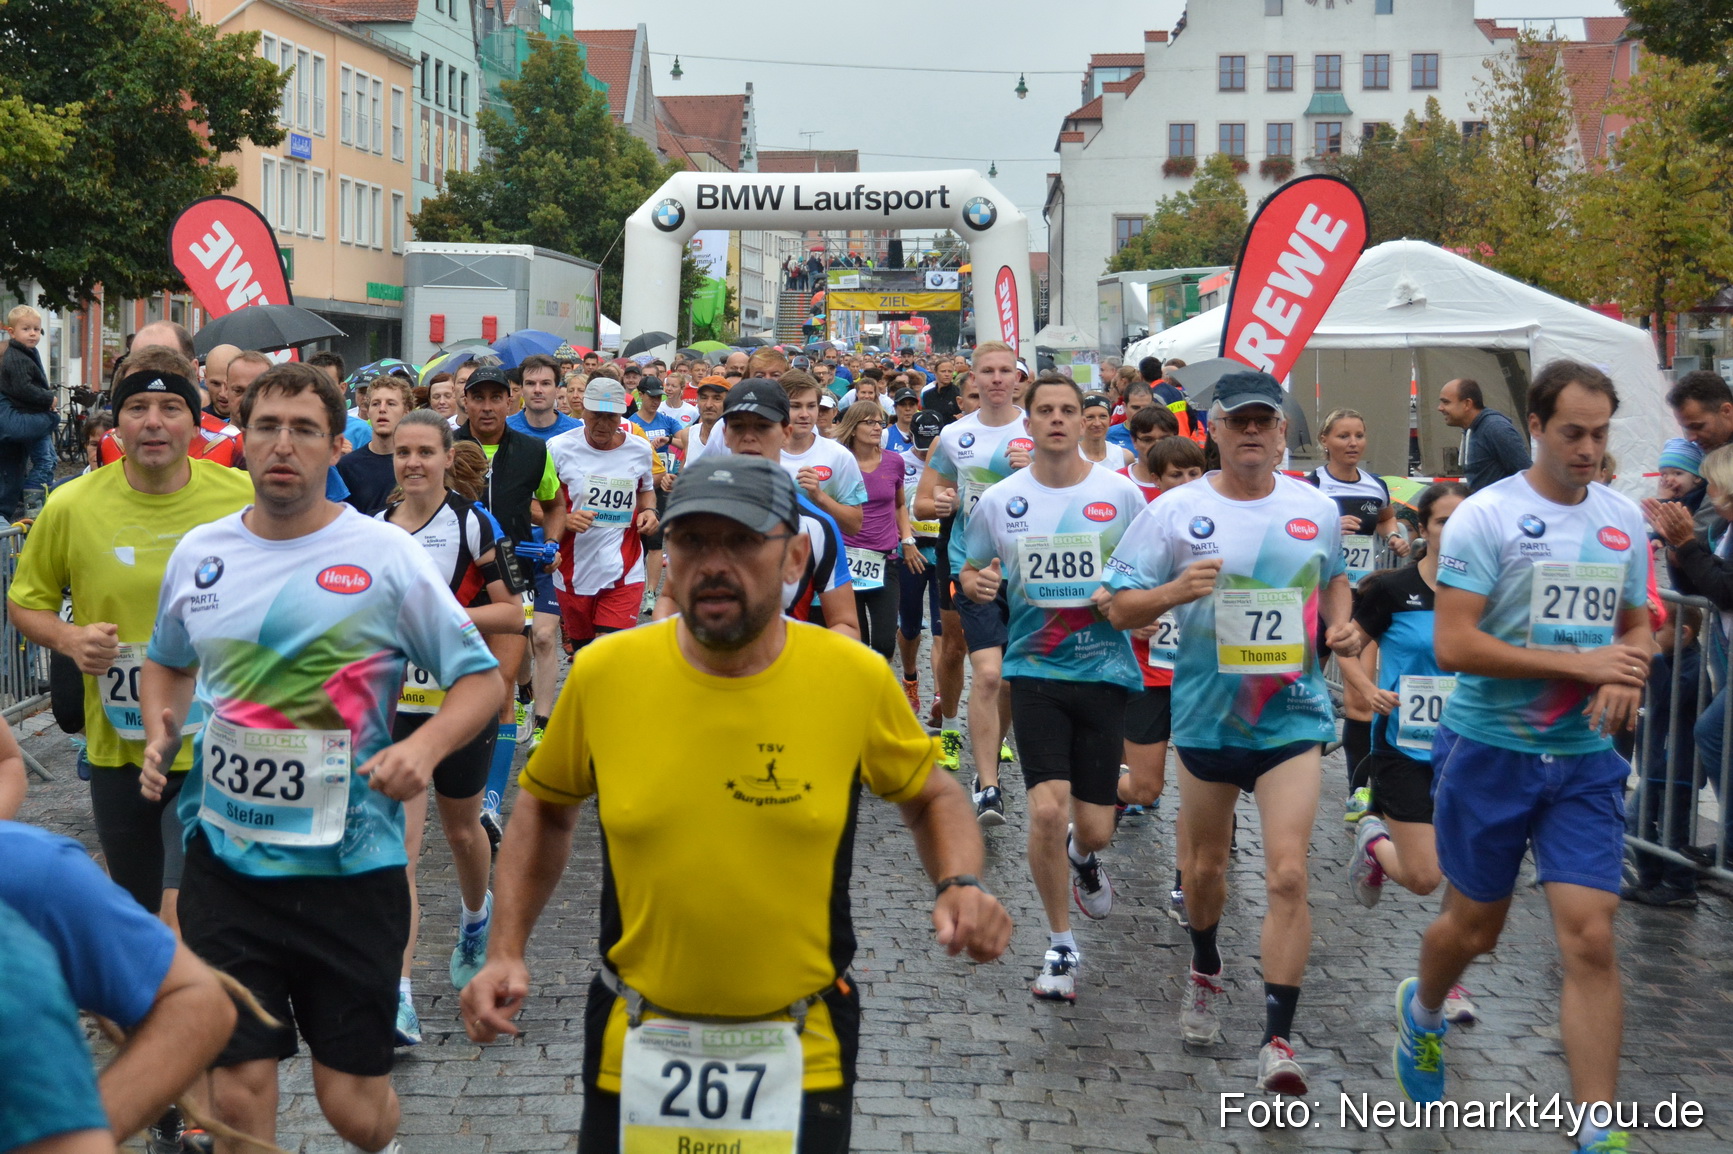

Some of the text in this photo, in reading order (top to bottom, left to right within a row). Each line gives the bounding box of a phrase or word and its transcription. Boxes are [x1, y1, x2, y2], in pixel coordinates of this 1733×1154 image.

[696, 184, 950, 216] BMW Laufsport
[1234, 203, 1348, 374] REWE
[880, 296, 909, 307] ZIEL
[999, 277, 1016, 350] REWE
[588, 487, 633, 509] 2494
[594, 511, 621, 521] Johann
[1087, 507, 1114, 517] Hervis
[1006, 521, 1028, 529] PARTL
[1289, 523, 1316, 535] Hervis
[1053, 534, 1093, 545] BOCK
[1601, 530, 1628, 544] Hervis
[1190, 542, 1219, 551] PARTL
[1520, 542, 1551, 551] PARTL
[1028, 551, 1095, 579] 2488
[1106, 555, 1135, 576] OCK
[1438, 556, 1468, 572] OCK
[1575, 566, 1619, 578] BOCK
[323, 571, 366, 588] Hervis
[1039, 586, 1085, 597] Christian
[1257, 591, 1297, 603] BOCK
[190, 594, 220, 605] PARTL
[1542, 585, 1617, 621] 2789
[190, 603, 219, 613] Neumarkt
[1245, 610, 1282, 641] 72
[1075, 630, 1094, 644] 17.
[1554, 629, 1604, 645] Matthias
[1074, 640, 1117, 652] Neumarkter
[1240, 650, 1287, 662] Thomas
[1288, 683, 1310, 697] 17.
[398, 692, 425, 703] Anne
[244, 732, 308, 749] BOCK
[757, 743, 785, 753] TSV
[211, 744, 305, 801] 2323
[733, 790, 803, 807] Burgthann
[226, 801, 275, 826] Stefan
[639, 1035, 692, 1049] NeuerMarkt
[702, 1028, 787, 1047] BOCK
[660, 1059, 767, 1120] 267
[678, 1135, 741, 1154] Bernd
